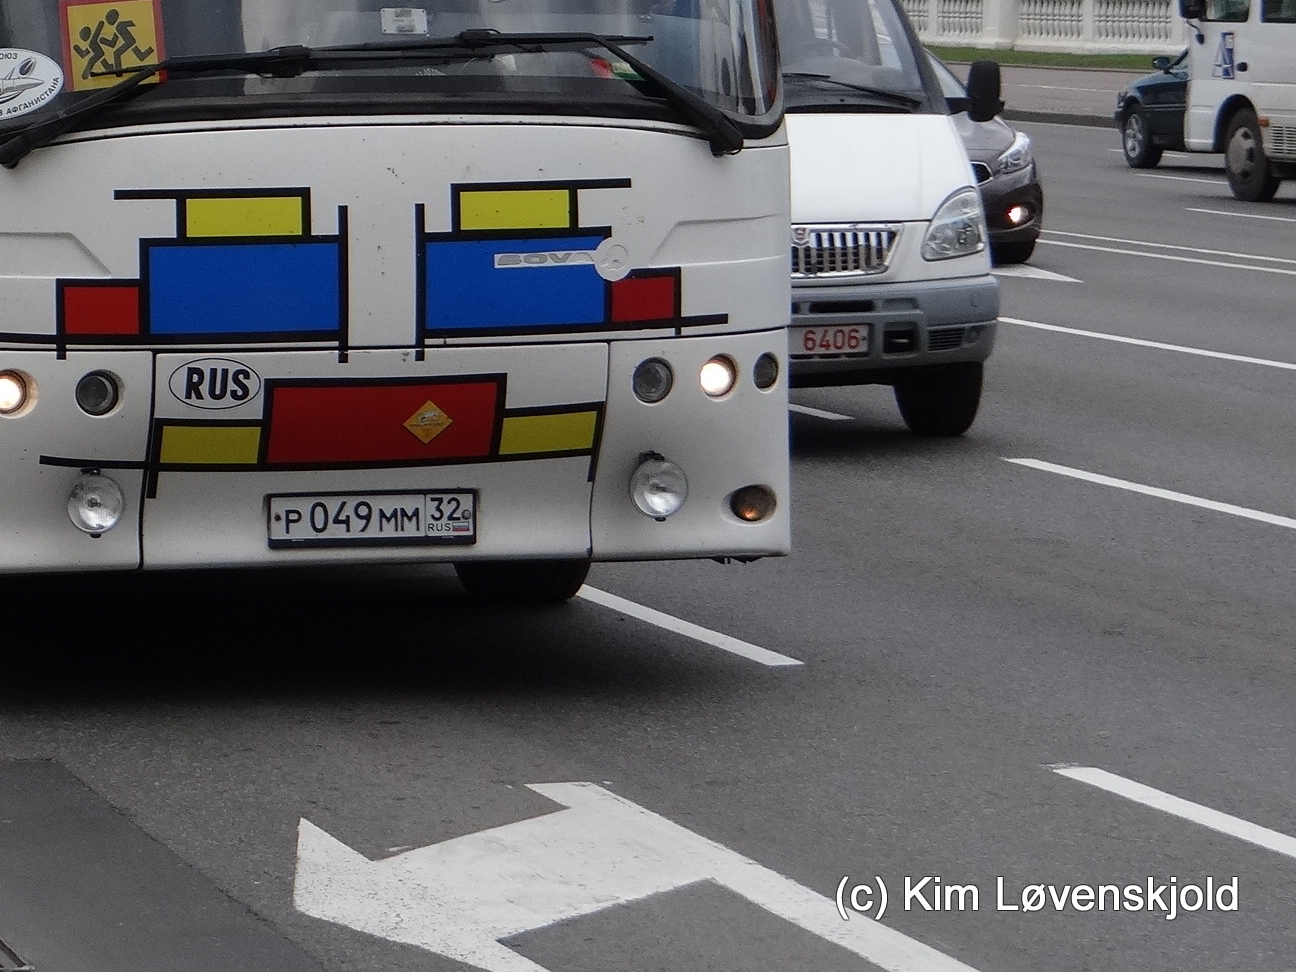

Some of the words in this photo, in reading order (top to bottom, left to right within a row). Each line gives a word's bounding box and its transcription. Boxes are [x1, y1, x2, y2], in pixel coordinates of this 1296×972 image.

[6, 76, 60, 115] АФГАНИСТАНА
[497, 251, 594, 266] BOVA
[804, 328, 860, 351] 6406
[185, 367, 250, 401] RUS
[430, 497, 461, 521] 32
[428, 523, 451, 532] RUS
